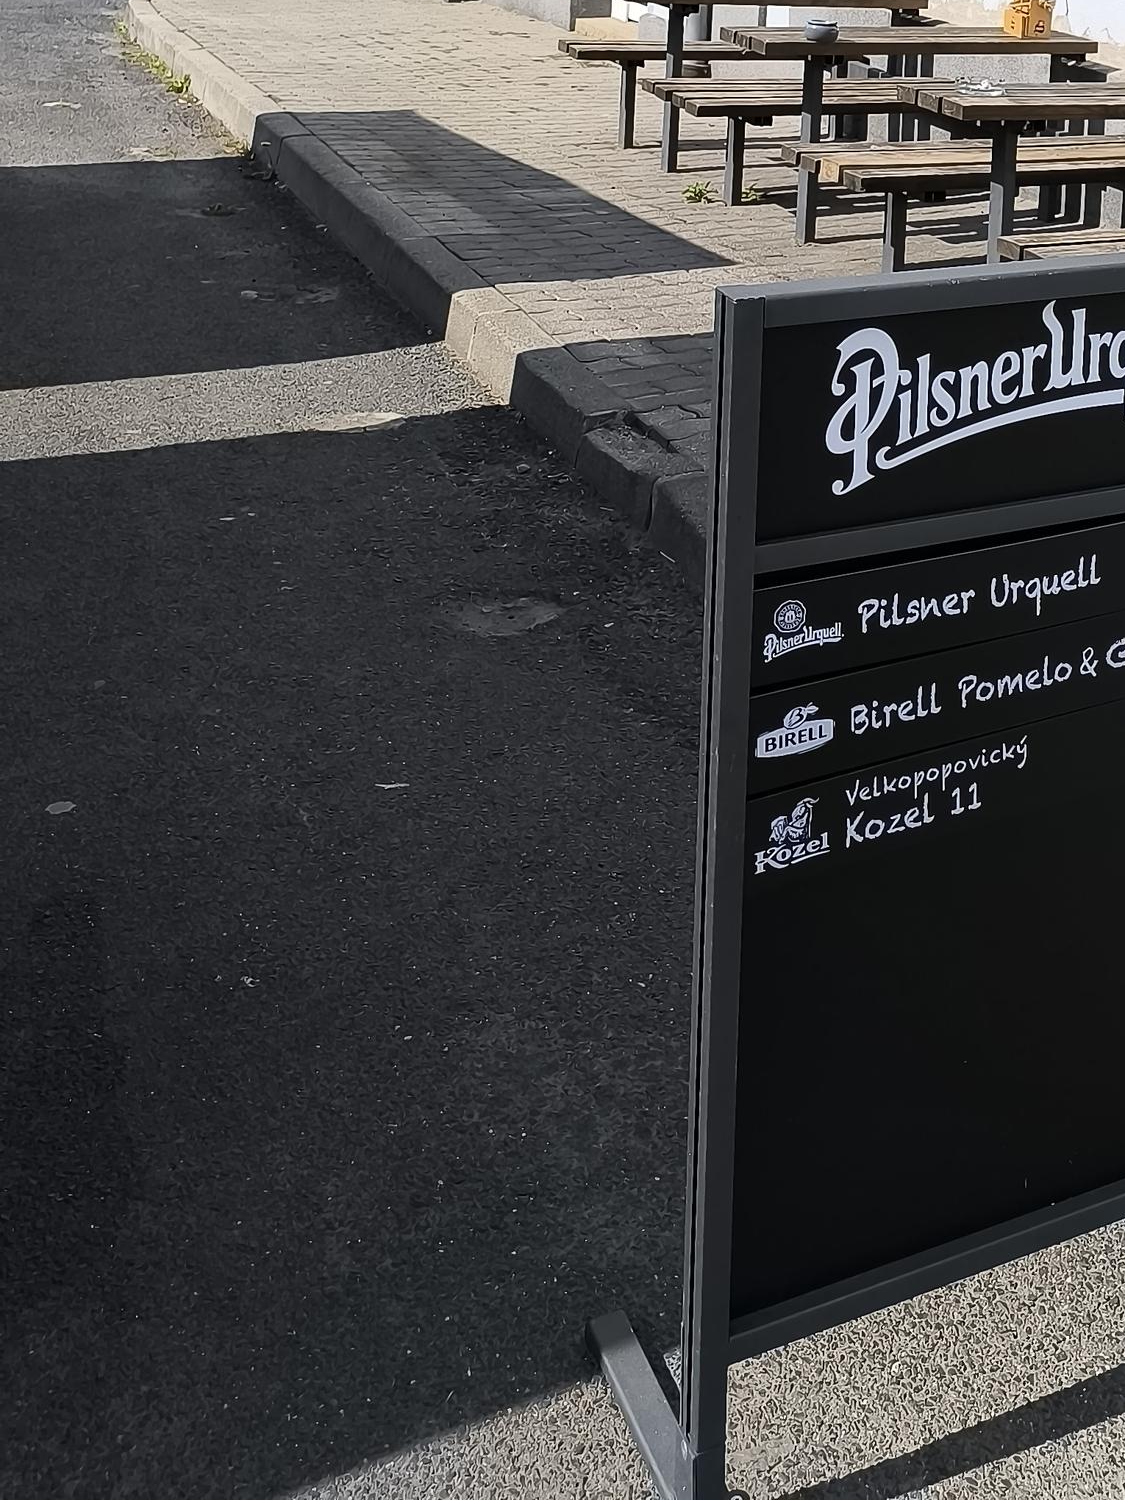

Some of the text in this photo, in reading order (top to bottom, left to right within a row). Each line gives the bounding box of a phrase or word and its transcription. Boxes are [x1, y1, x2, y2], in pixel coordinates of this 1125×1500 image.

[825, 327, 1048, 496] Pilsner
[857, 588, 977, 634] Pilsner
[990, 553, 1102, 617] Urquell
[763, 633, 805, 663] Pilsner
[850, 684, 943, 736] Birell
[957, 655, 1074, 709] Pomelo
[1079, 646, 1099, 677] &
[764, 724, 828, 753] BIRELL
[845, 734, 1030, 806] Velkopopovický
[845, 782, 983, 849] Kozel 11
[754, 831, 831, 875] Kozel
